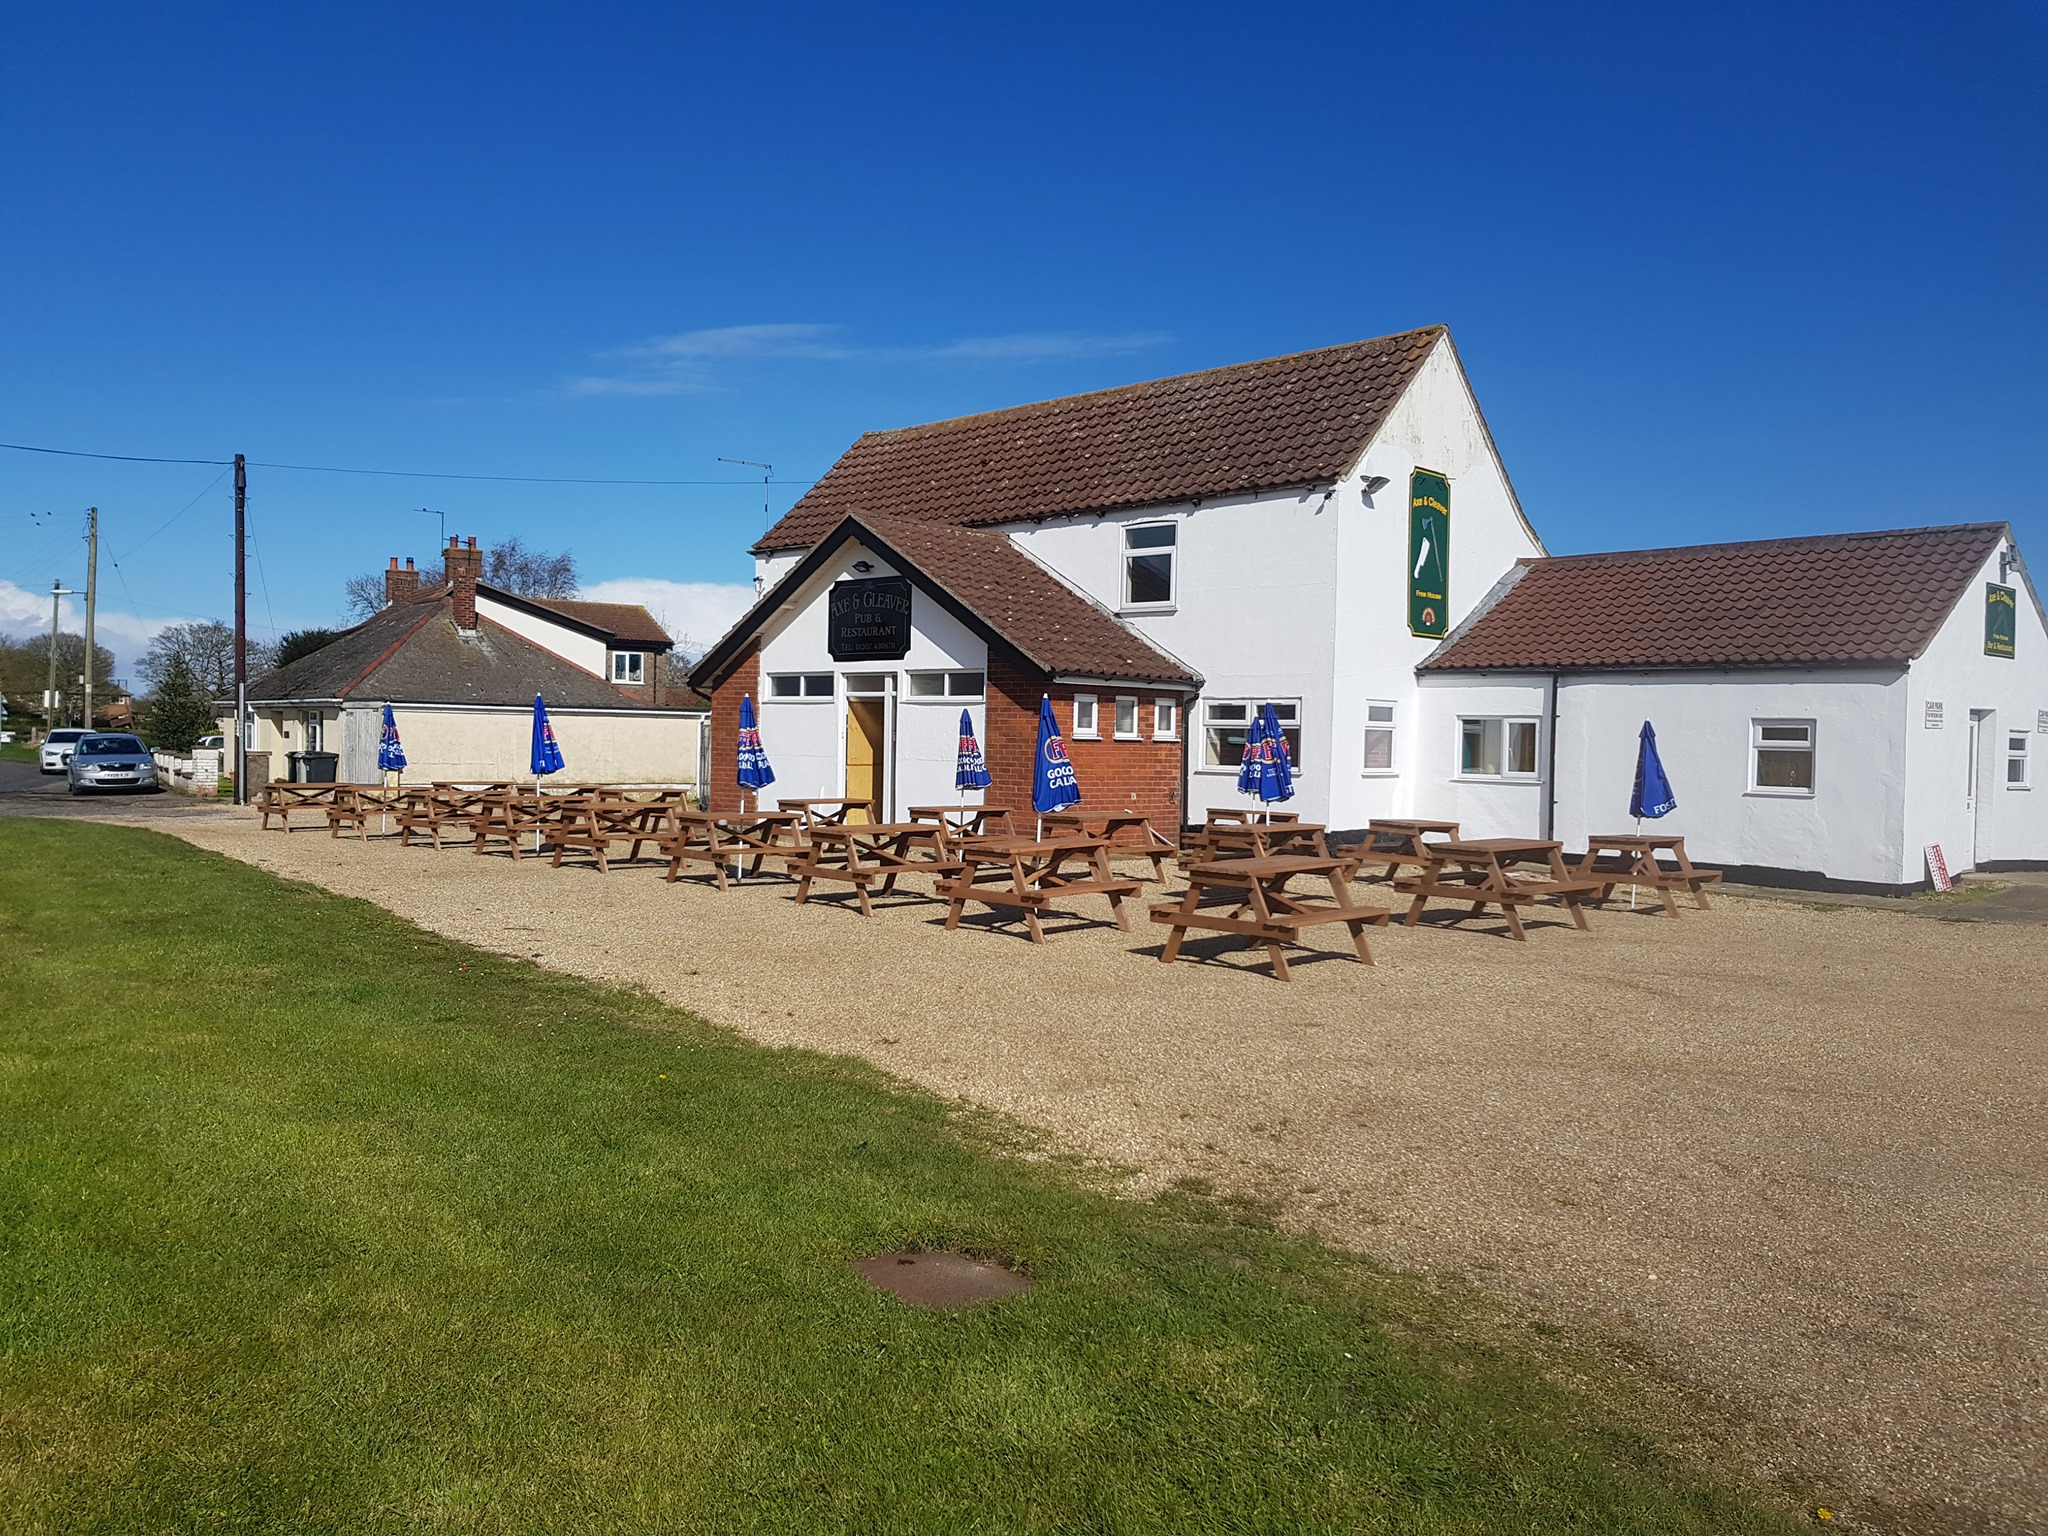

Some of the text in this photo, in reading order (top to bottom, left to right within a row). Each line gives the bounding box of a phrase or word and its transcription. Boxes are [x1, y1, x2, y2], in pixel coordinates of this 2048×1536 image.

[831, 597, 850, 619] AXE
[853, 593, 860, 609] &
[854, 613, 882, 623] PUB &
[841, 626, 896, 637] RESTAURANT
[855, 643, 872, 651] 01507
